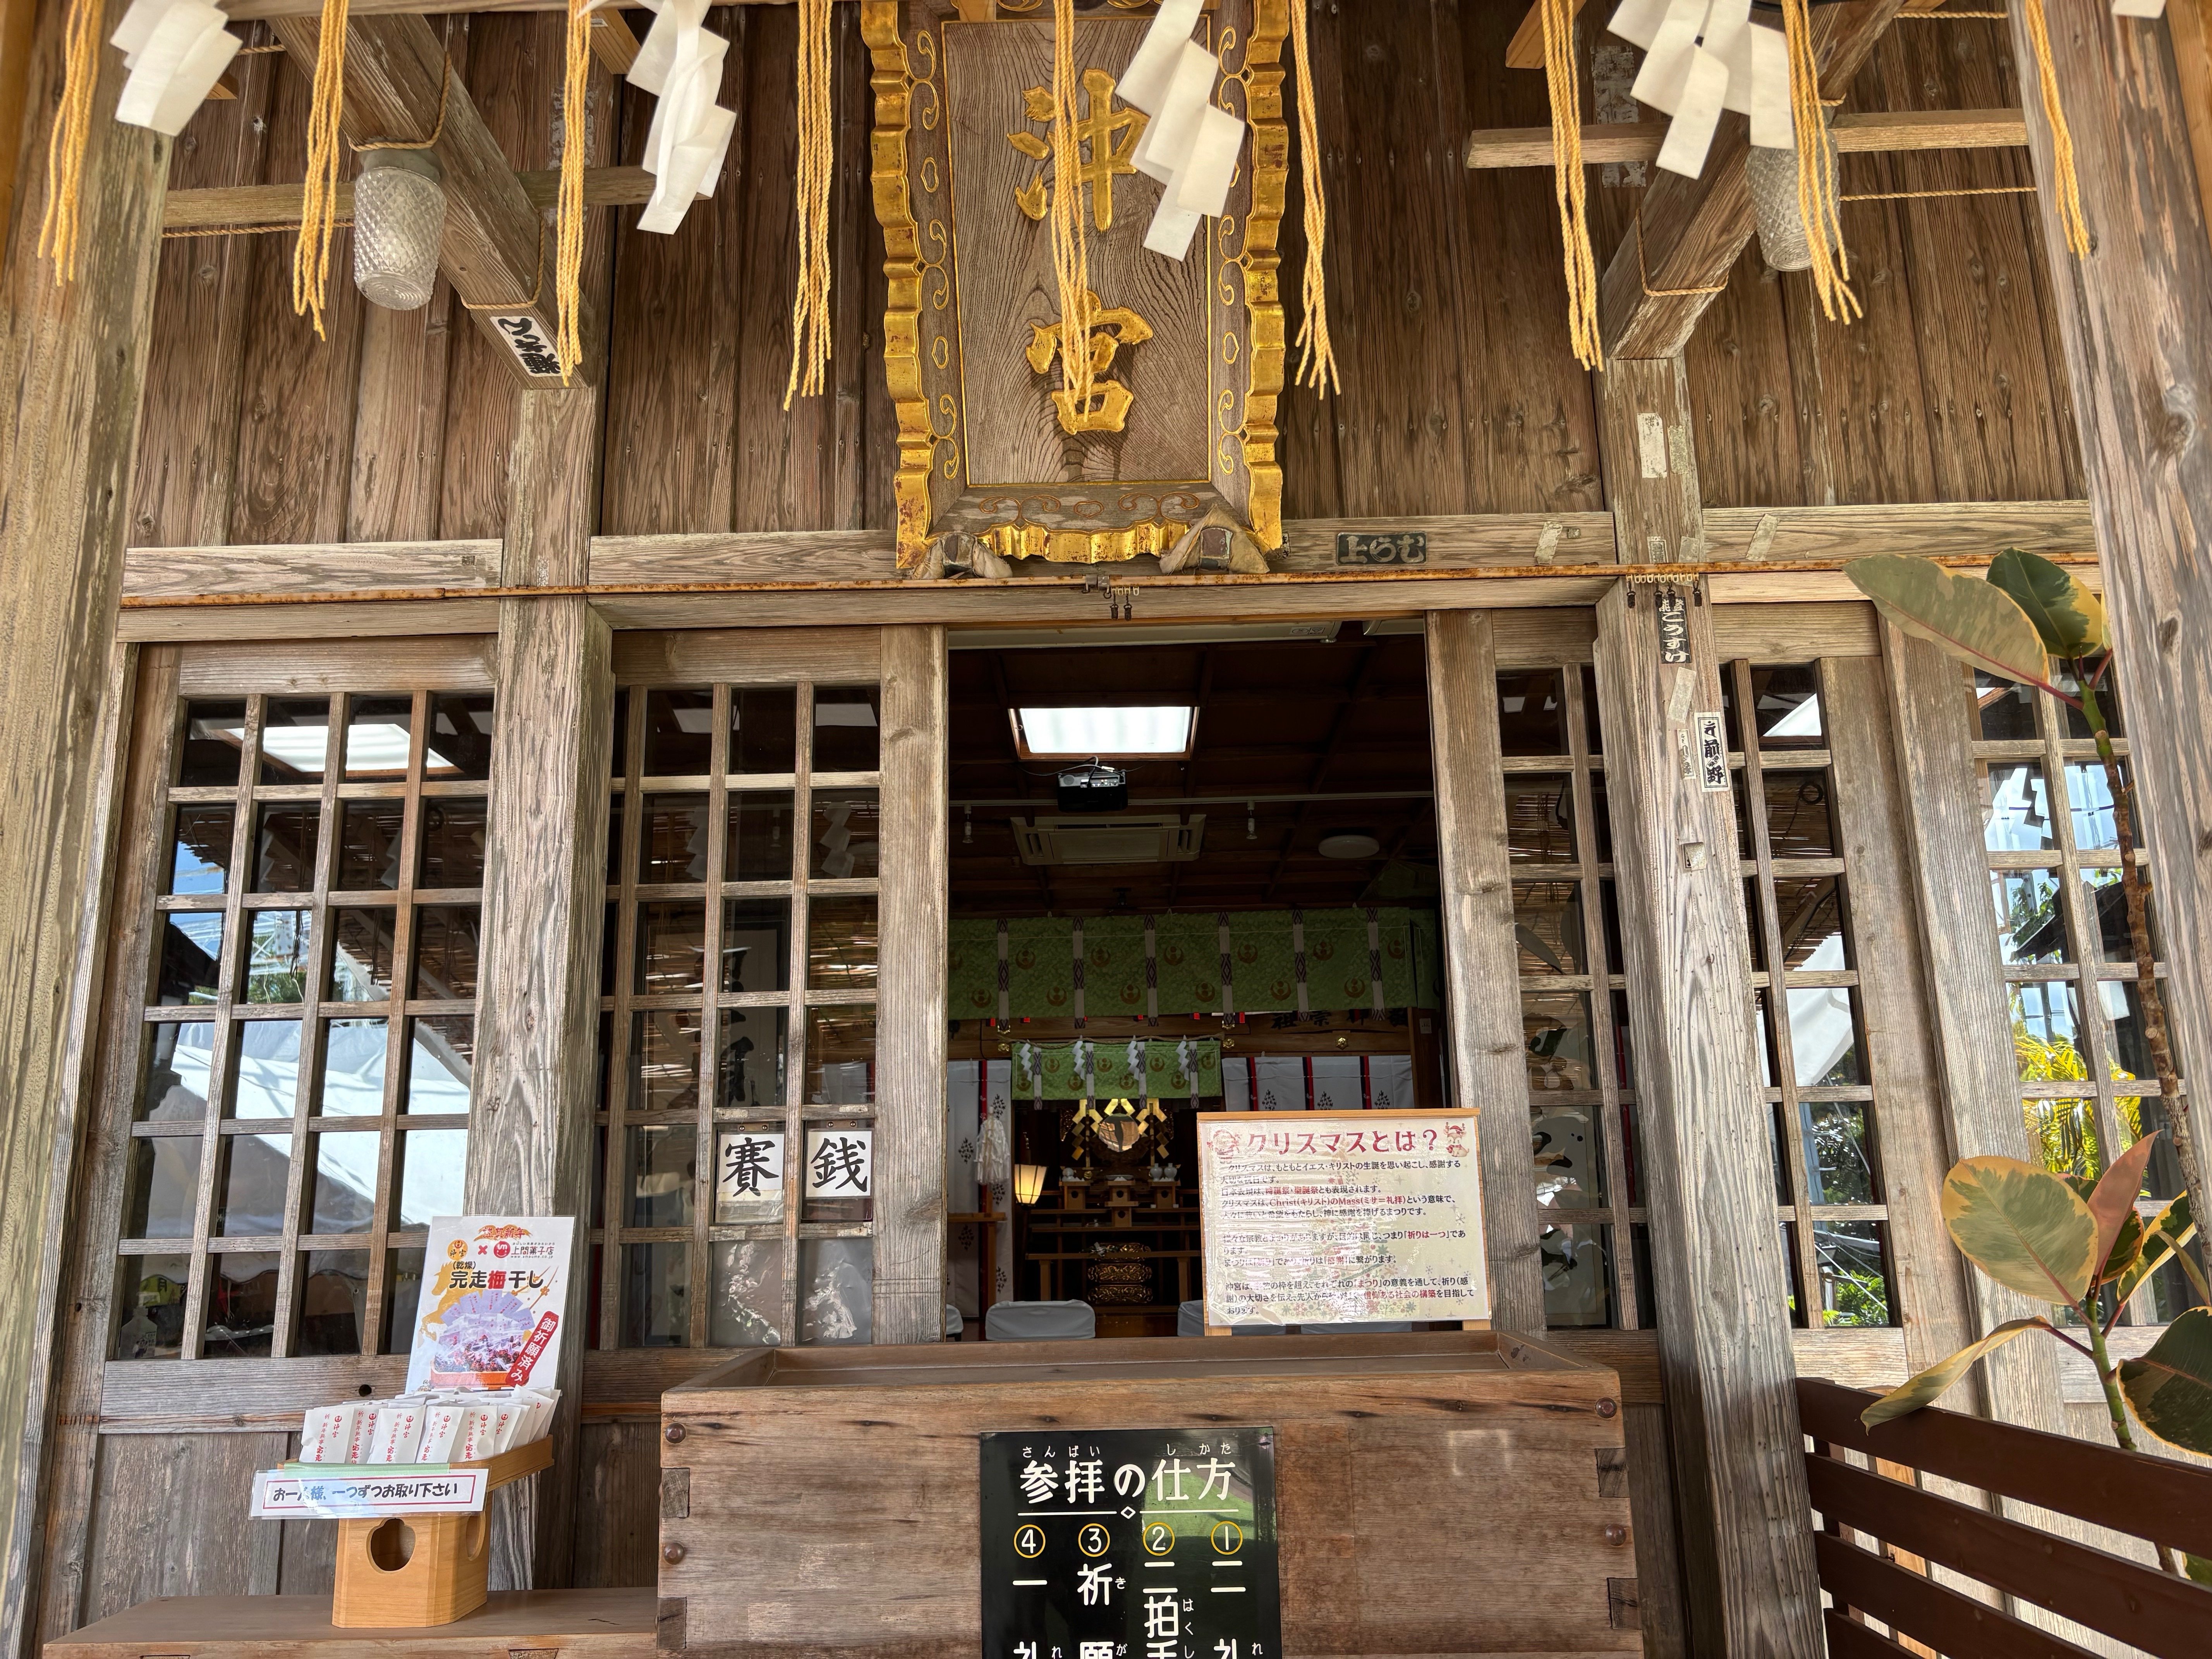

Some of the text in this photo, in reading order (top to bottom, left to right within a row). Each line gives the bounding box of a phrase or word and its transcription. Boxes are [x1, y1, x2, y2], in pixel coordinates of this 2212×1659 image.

[1007, 68, 1152, 434] 沖宮
[723, 1137, 868, 1197] 賽 銭
[1247, 1129, 1438, 1155] クリスマスとは？
[449, 1270, 544, 1289] 完走梅干し
[510, 1317, 557, 1382] 御祈願済み
[1020, 1457, 1236, 1504] 参拝の仕方
